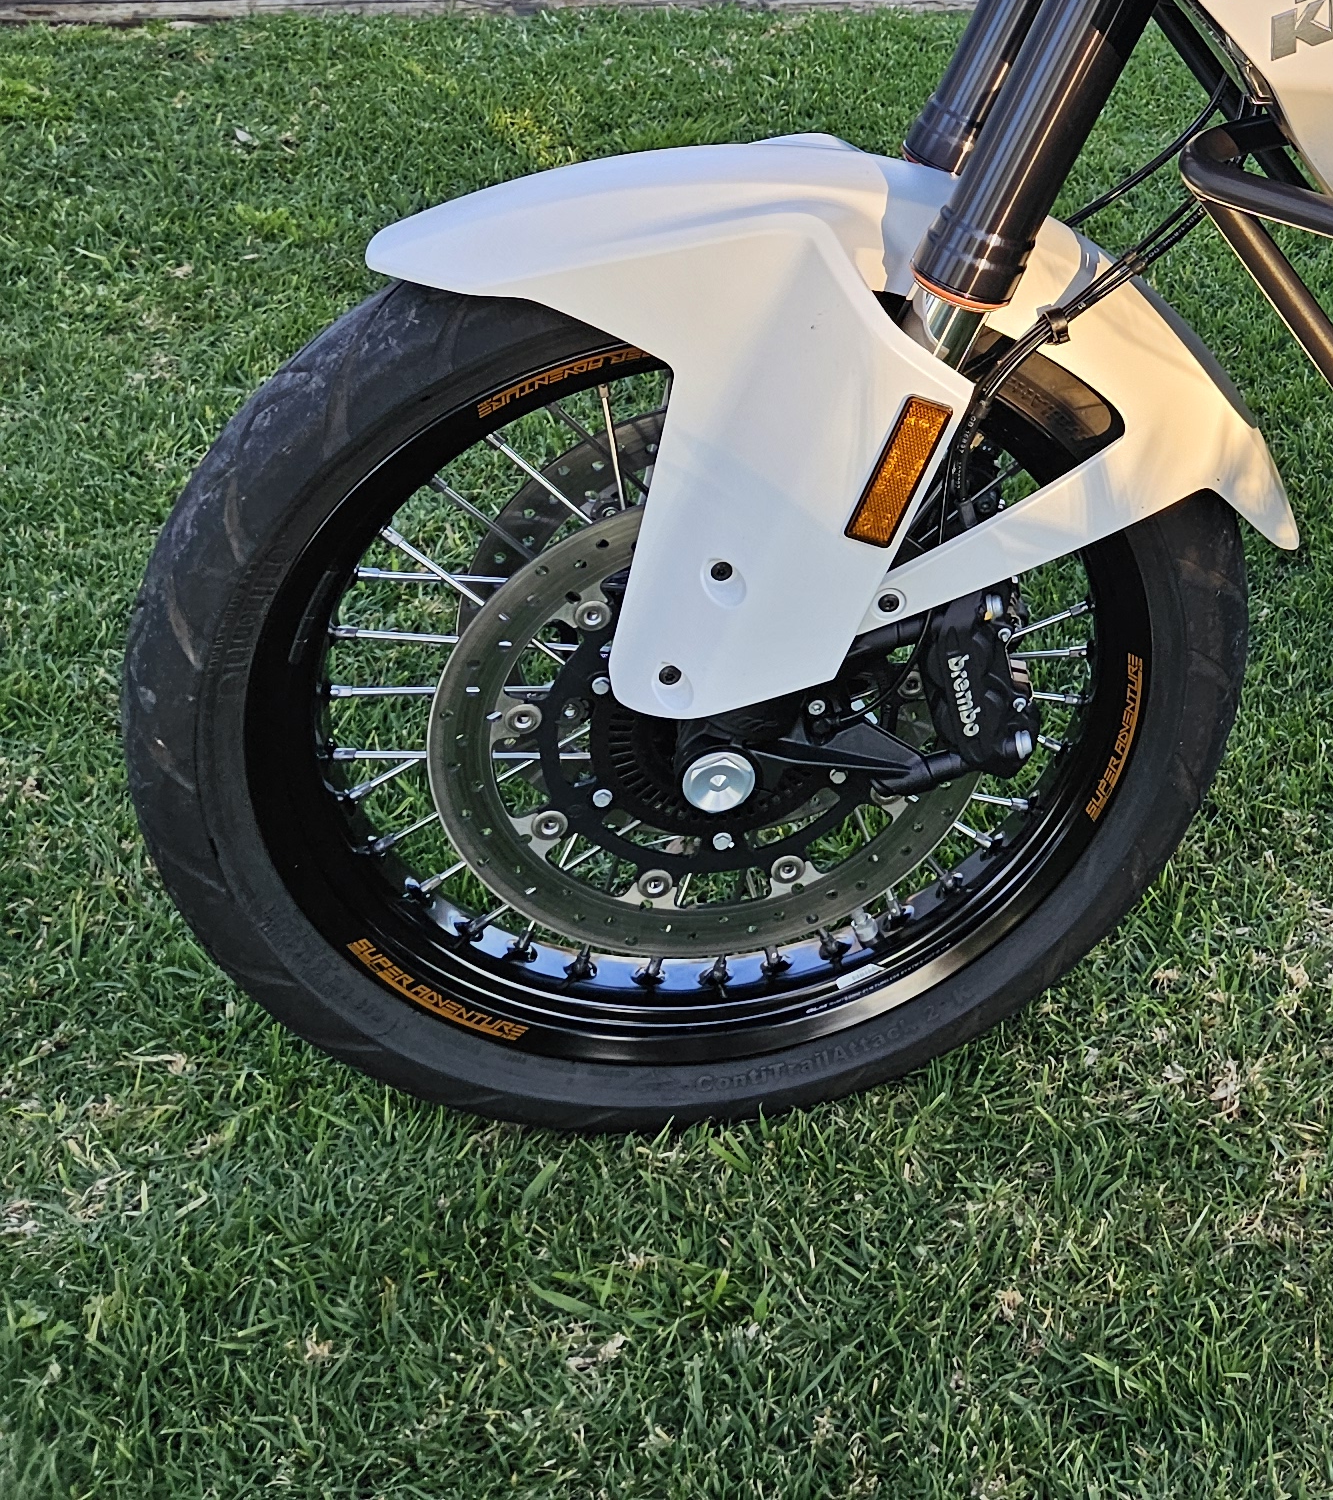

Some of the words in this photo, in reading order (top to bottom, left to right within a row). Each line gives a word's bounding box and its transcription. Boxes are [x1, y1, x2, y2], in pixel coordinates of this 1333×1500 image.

[947, 653, 981, 737] brembo
[1085, 756, 1121, 818] SUPER
[1115, 653, 1140, 756] ADVENTURE
[353, 938, 415, 988] SUPER
[411, 985, 530, 1038] ADVENTURE
